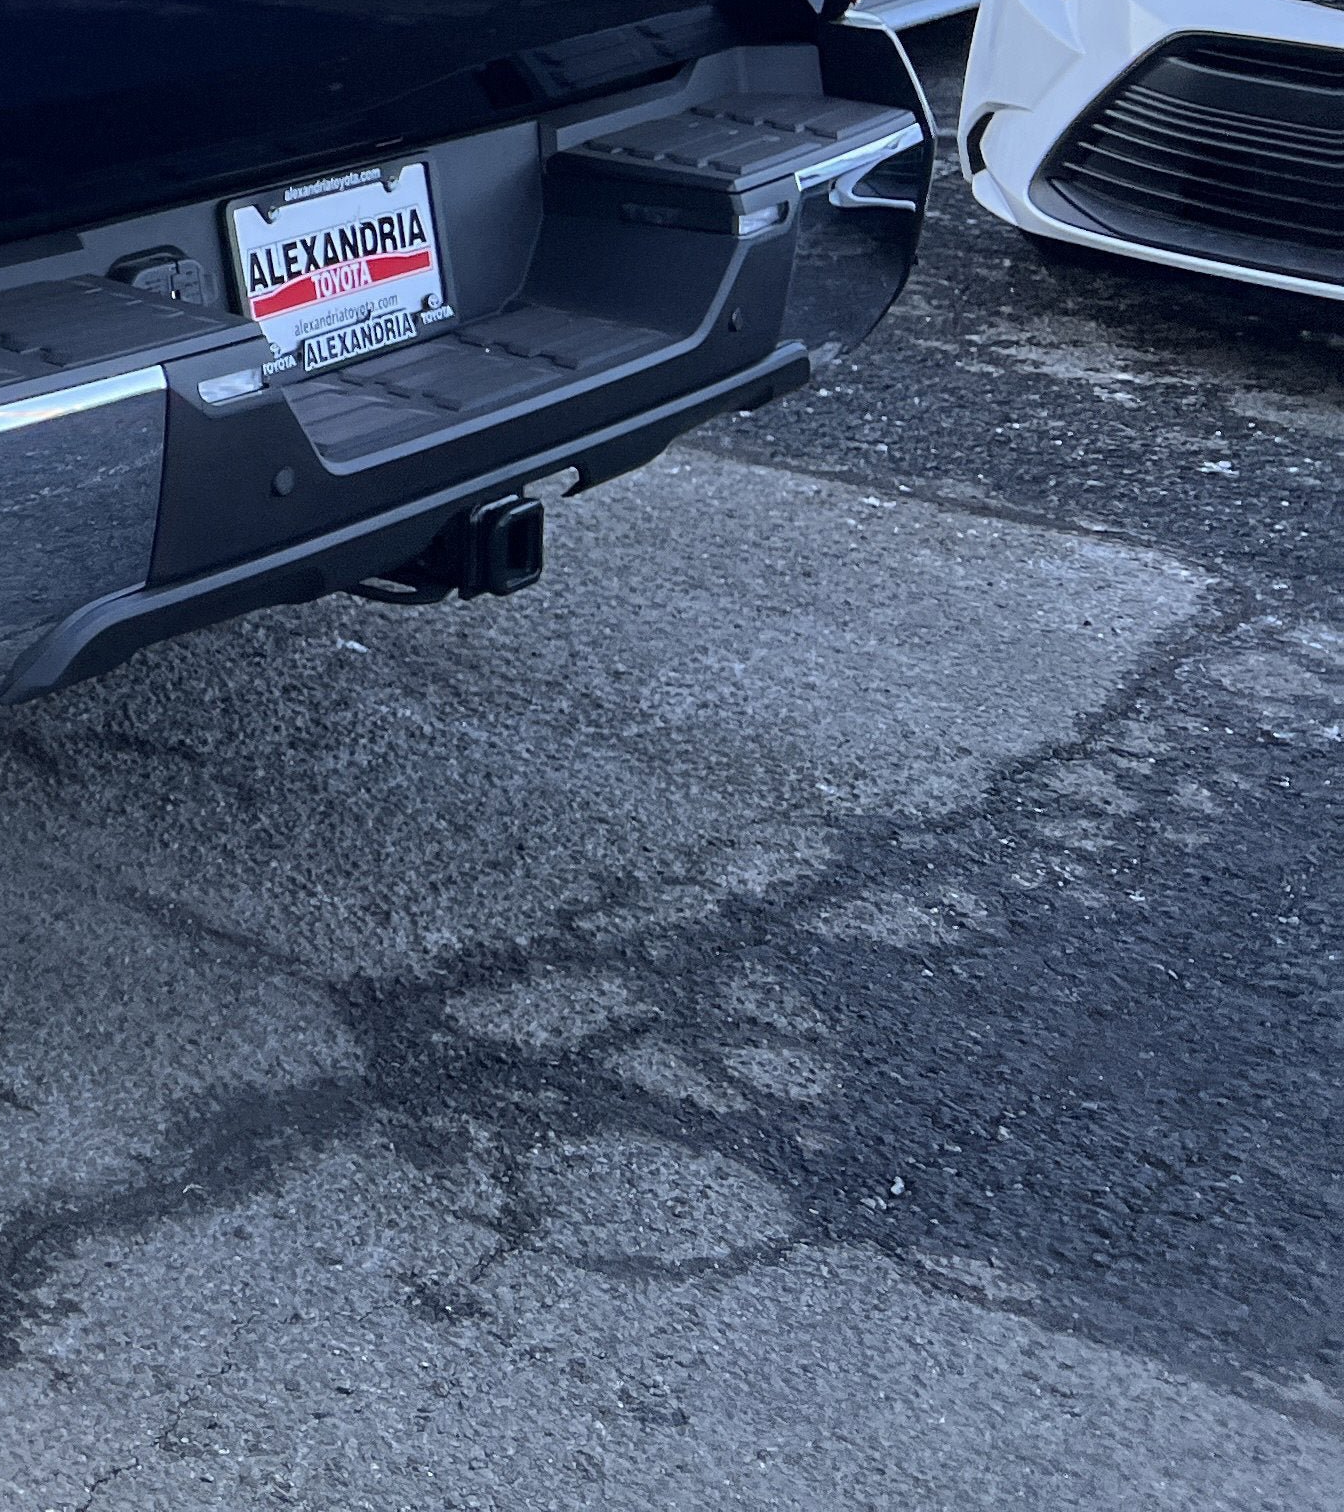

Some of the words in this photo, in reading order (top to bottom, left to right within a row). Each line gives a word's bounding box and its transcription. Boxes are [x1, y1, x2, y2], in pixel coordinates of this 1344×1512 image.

[284, 167, 382, 202] alexandriatoyota.com
[248, 208, 428, 293] ALEXANDRIA
[311, 261, 374, 300] TOYOTA
[294, 294, 399, 337] alexandriatoyota.com
[420, 304, 455, 325] TOYOTA
[305, 311, 415, 365] ALEXANDRIA
[262, 354, 297, 376] TOYOTA
